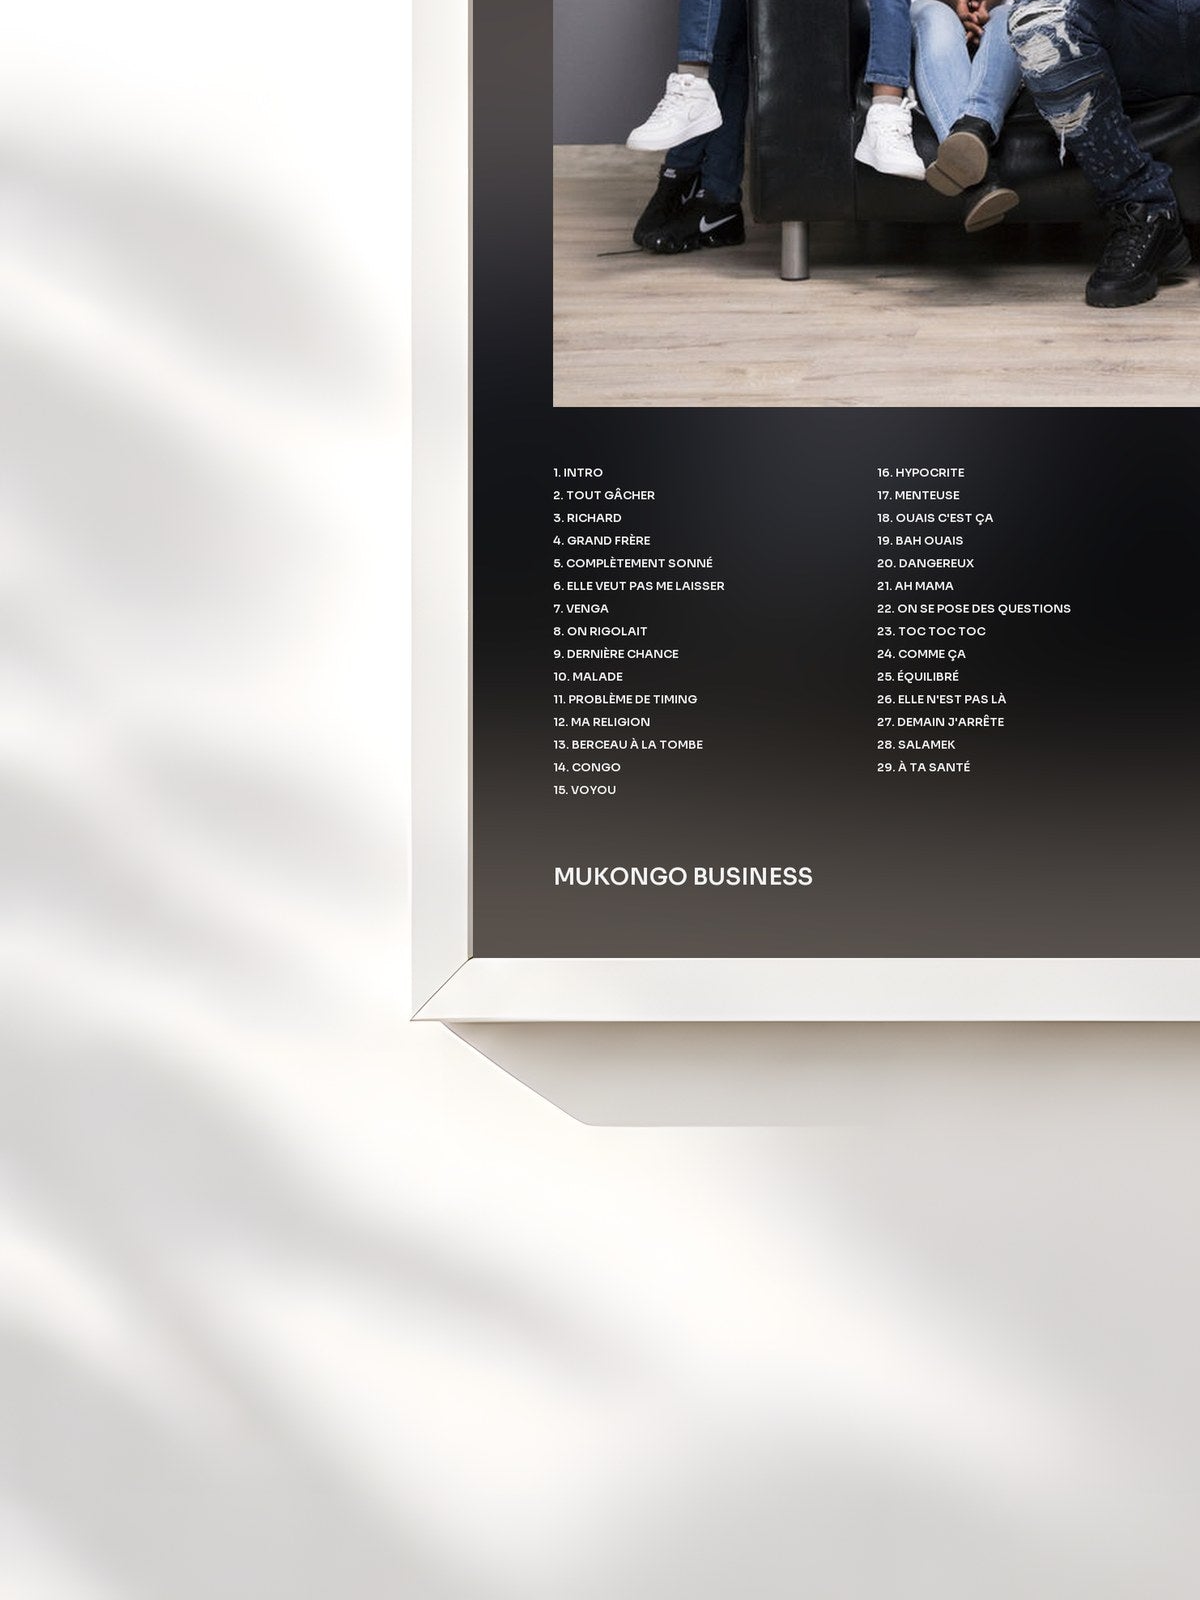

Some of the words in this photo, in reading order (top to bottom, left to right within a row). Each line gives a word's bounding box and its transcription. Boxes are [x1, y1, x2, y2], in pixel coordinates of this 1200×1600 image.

[553, 468, 561, 478] 1.
[563, 468, 604, 478] INTRO
[877, 468, 893, 478] 16.
[895, 468, 965, 478] HYPOCRITE
[553, 490, 564, 500] 2.
[566, 490, 601, 500] TOUT
[604, 488, 656, 500] GÂCHER
[877, 490, 892, 500] 17.
[894, 490, 960, 500] MENTEUSE
[553, 513, 565, 523] 3.
[567, 513, 622, 523] RICHARD
[877, 513, 893, 523] 18.
[895, 513, 935, 523] OUAIS
[937, 513, 973, 523] C'EST
[975, 513, 994, 525] ÇA
[552, 536, 565, 546] 4.
[567, 536, 612, 546] GRAND
[614, 533, 651, 546] FRÈRE
[877, 536, 893, 546] 19.
[895, 536, 922, 546] BAH
[924, 536, 964, 546] OUAIS
[553, 558, 564, 568] 5.
[566, 556, 666, 568] COMPLÈTEMENT
[668, 556, 713, 568] SONNÉ
[877, 558, 896, 568] 20.
[899, 558, 975, 568] DANGEREUX
[553, 581, 565, 591] 6.
[566, 581, 593, 591] ELLE
[595, 581, 627, 591] VEUT
[629, 581, 654, 591] PAS
[655, 581, 674, 591] ME
[675, 581, 725, 591] LAISSER
[877, 581, 892, 591] 21.
[894, 581, 913, 591] AH
[915, 581, 954, 591] MAMA
[553, 604, 564, 614] 7.
[566, 604, 609, 614] VENGA
[877, 604, 895, 614] 22.
[897, 604, 918, 614] ON
[919, 604, 935, 614] SE
[937, 604, 970, 614] POSE
[971, 604, 995, 614] DES
[997, 604, 1072, 616] QUESTIONS
[553, 626, 565, 636] 8.
[567, 626, 587, 636] ON
[589, 626, 648, 636] RIGOLAIT
[877, 626, 896, 636] 23.
[898, 626, 927, 636] TOC
[928, 626, 957, 636] TOC
[958, 626, 987, 636] TOC
[553, 649, 565, 659] 9.
[566, 646, 625, 659] DERNIÈRE
[627, 649, 679, 659] CHANCE
[877, 649, 896, 659] 24.
[898, 649, 946, 659] COMME
[947, 649, 967, 661] ÇA
[553, 672, 570, 682] 10.
[572, 672, 623, 682] MALADE
[877, 672, 895, 682] 25.
[897, 669, 959, 684] ÉQUILIBRÉ
[553, 694, 566, 704] 11.
[568, 692, 633, 704] PROBLÈME
[635, 694, 651, 704] DE
[653, 694, 698, 704] TIMING
[877, 694, 896, 704] 26.
[898, 694, 925, 704] ELLE
[926, 694, 962, 704] N'EST
[964, 694, 989, 704] PAS
[991, 692, 1007, 704] LÀ
[553, 717, 569, 727] 12.
[571, 717, 591, 727] MA
[592, 717, 651, 727] RELIGION
[877, 717, 895, 727] 27.
[897, 717, 945, 727] DEMAIN
[947, 714, 1005, 727] J'ARRÊTE
[553, 740, 569, 750] 13.
[571, 740, 628, 750] BERCEAU
[629, 737, 639, 750] À
[641, 740, 657, 750] LA
[659, 740, 704, 750] TOMBE
[877, 740, 896, 750] 28.
[898, 740, 956, 750] SALAMEK
[553, 762, 569, 772] 14.
[571, 762, 621, 772] CONGO
[877, 762, 896, 772] 29.
[897, 760, 907, 772] À
[909, 762, 927, 772] TA
[928, 760, 971, 772] SANTÉ
[553, 785, 569, 795] 15.
[570, 785, 617, 795] VOYOU
[553, 866, 688, 887] MUKONGO
[693, 866, 814, 887] BUSINESS
